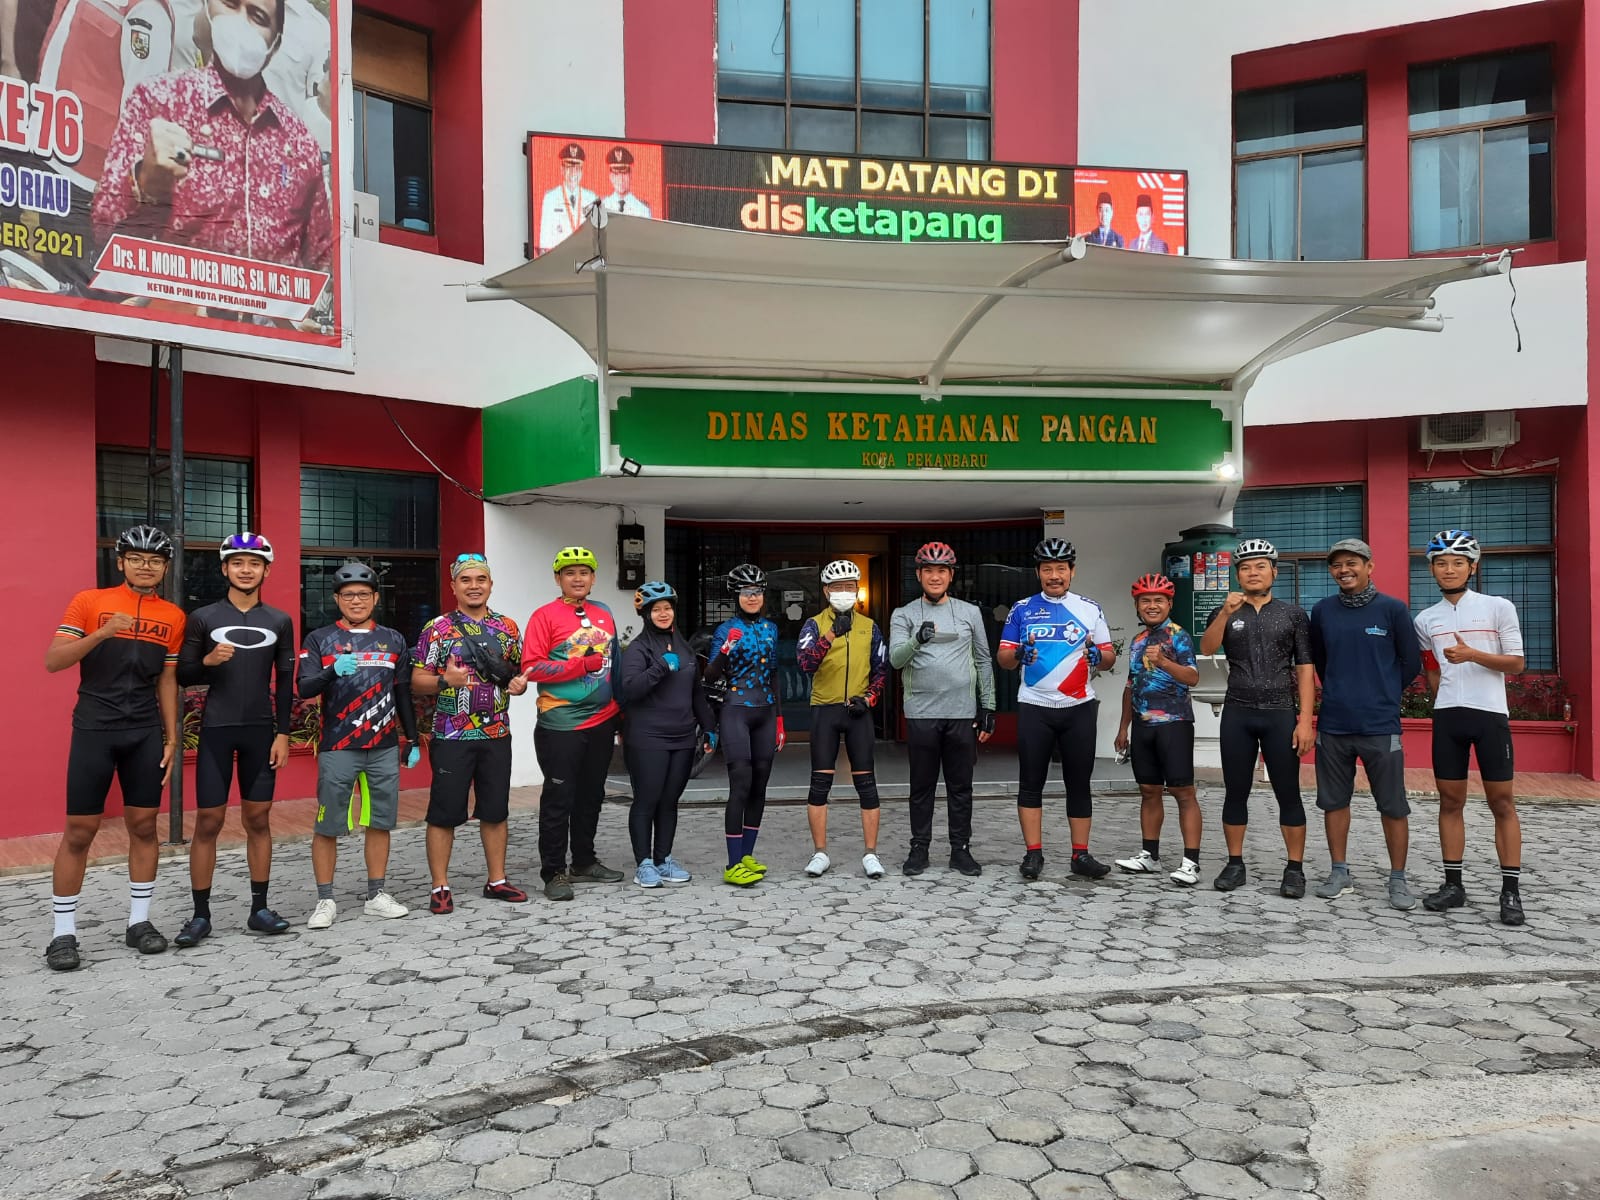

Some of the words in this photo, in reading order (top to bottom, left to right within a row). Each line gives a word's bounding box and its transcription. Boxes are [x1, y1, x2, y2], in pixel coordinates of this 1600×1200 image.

[0, 81, 26, 145] E
[35, 89, 79, 156] 76
[20, 170, 69, 213] RIAU
[860, 160, 1006, 196] DATANG
[1018, 168, 1058, 199] DI
[362, 217, 374, 226] LG
[740, 193, 1003, 243] disketapang
[0, 222, 28, 249] ER
[34, 228, 82, 258] 2021
[112, 243, 136, 270] Drs.
[138, 248, 149, 273] H.
[152, 250, 188, 280] MOHD.
[190, 257, 219, 285] NOER
[221, 263, 248, 291] MBS,
[294, 276, 311, 300] MH
[147, 282, 175, 296] KETUA
[177, 286, 193, 298] PMI
[195, 289, 216, 302] KOTA
[218, 293, 267, 310] PEKANBARU
[706, 411, 808, 441] DINAS
[827, 412, 1020, 442] KETAHANAN
[1041, 415, 1157, 443] PANGAN
[862, 452, 895, 468] KOTA
[907, 453, 988, 469] PEKANBARU
[1031, 627, 1056, 637] FDJ
[336, 682, 382, 720] YETI
[352, 692, 391, 727] YETI
